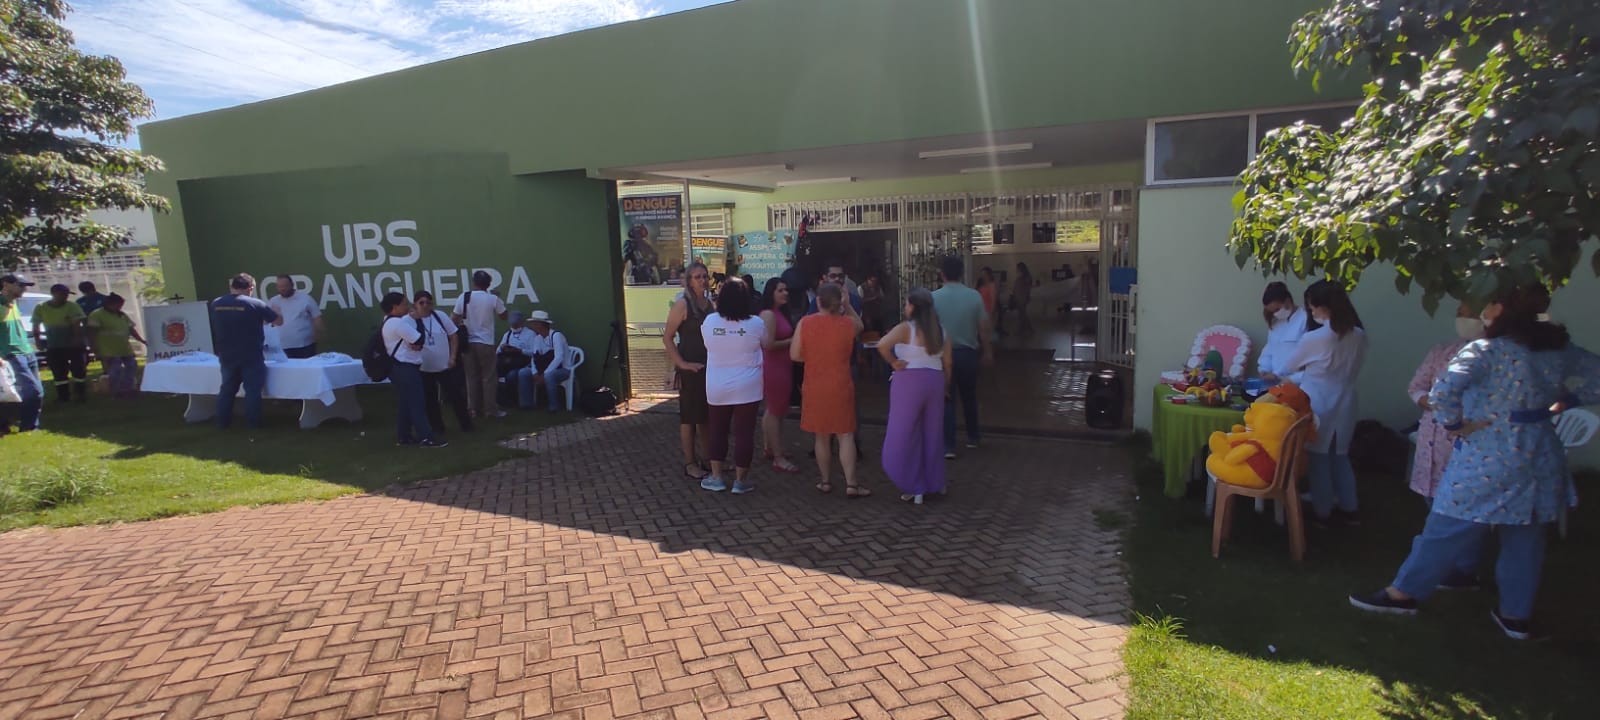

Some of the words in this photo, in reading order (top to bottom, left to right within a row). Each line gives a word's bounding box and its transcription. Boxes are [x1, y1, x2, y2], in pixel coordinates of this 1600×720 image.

[624, 197, 677, 211] DENGUE
[321, 220, 420, 268] UBS
[692, 238, 725, 247] DENGUE
